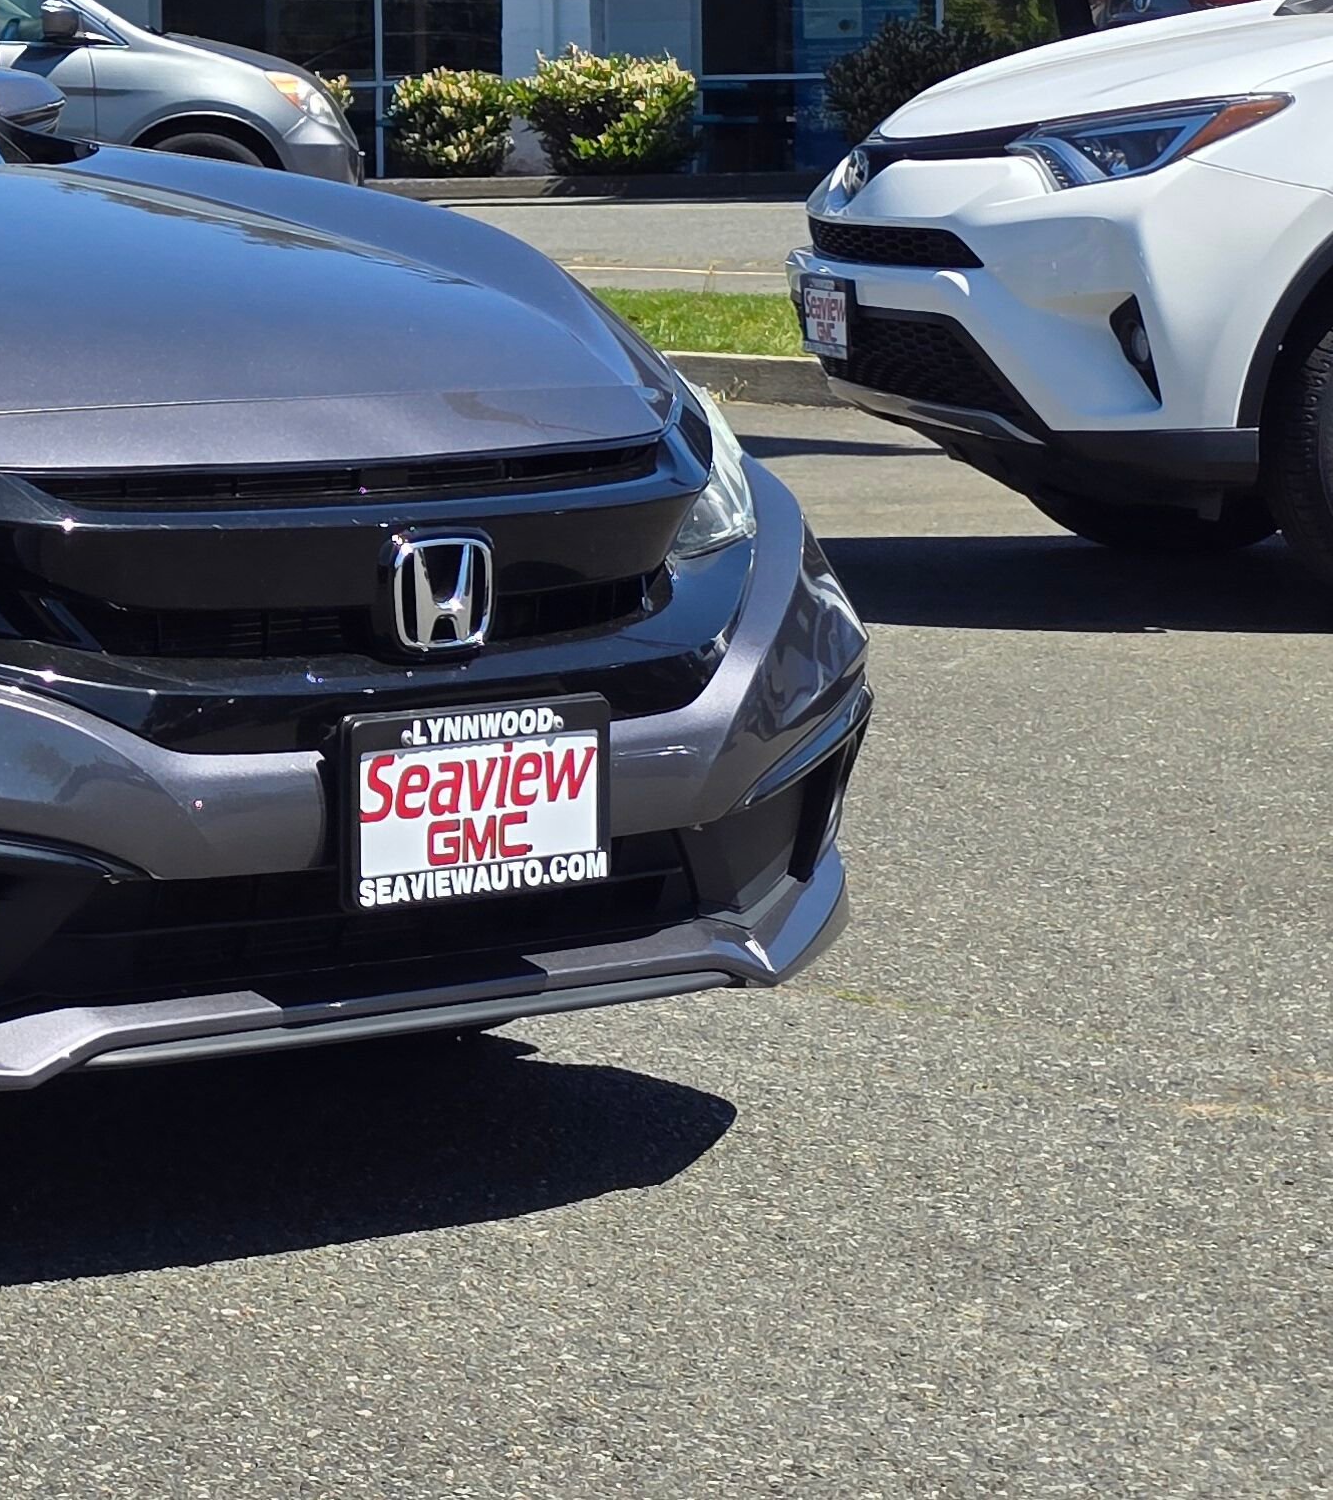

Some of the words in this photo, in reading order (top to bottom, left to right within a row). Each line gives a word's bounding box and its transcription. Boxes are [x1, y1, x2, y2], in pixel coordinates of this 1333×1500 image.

[805, 290, 846, 322] Seaview
[412, 707, 554, 746] LYNNWOOD
[359, 742, 597, 824] Seaview
[427, 811, 530, 866] GMC
[359, 851, 607, 908] SEAVIEWAUTO.COM
